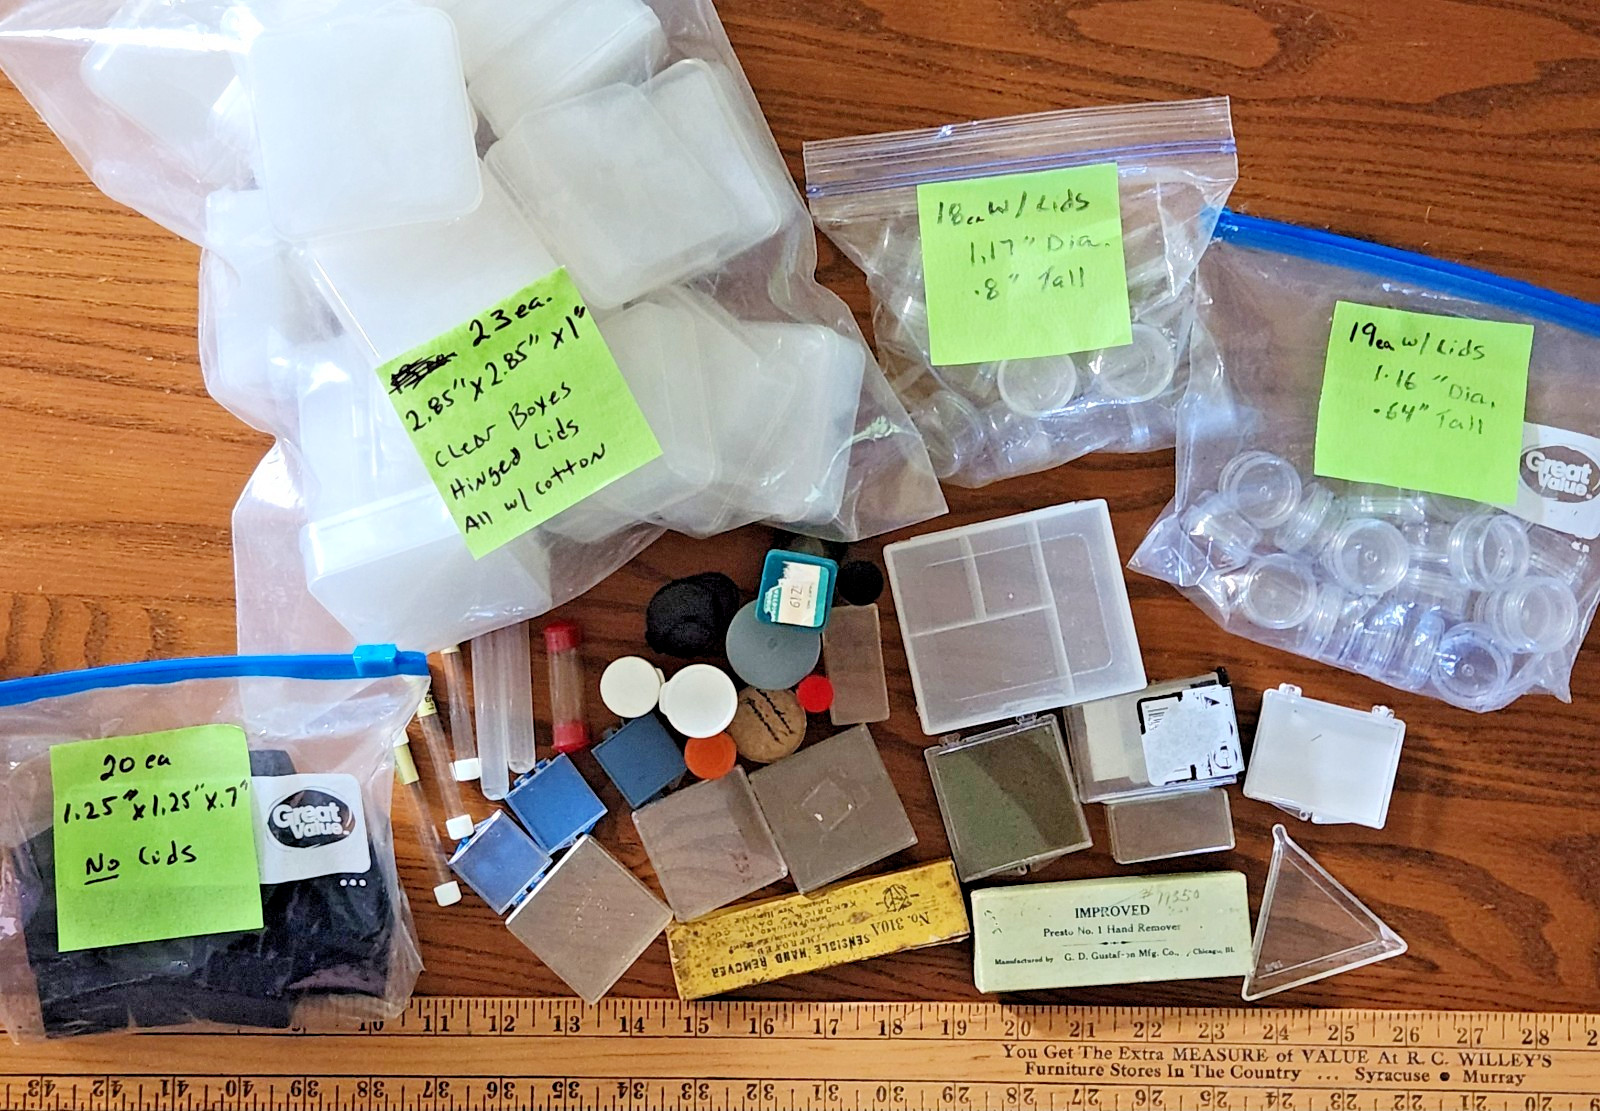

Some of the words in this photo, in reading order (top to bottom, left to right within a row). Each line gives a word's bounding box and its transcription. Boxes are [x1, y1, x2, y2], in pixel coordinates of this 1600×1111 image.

[1038, 267, 1084, 290] Tall
[509, 382, 571, 430] Boxes
[1437, 409, 1483, 434] Tall
[450, 448, 520, 499] Hinged
[1526, 451, 1592, 484] Great
[1538, 474, 1587, 496] Value
[466, 512, 492, 533] All
[100, 755, 135, 781] 20
[146, 755, 171, 768] ea
[273, 801, 341, 828] Great
[290, 822, 343, 839] Value
[86, 853, 120, 875] No
[906, 911, 931, 929] No.
[1075, 905, 1150, 919] IMPROVED
[738, 918, 774, 934] DAVI
[870, 916, 905, 937] 310A
[1044, 928, 1074, 937] Presto
[1078, 926, 1094, 935] No.
[1097, 926, 1102, 934] 1
[1107, 924, 1134, 934] Hand
[1138, 923, 1181, 933] Remover
[813, 932, 870, 956] SENSIBLE
[710, 955, 768, 980] REMOVER
[773, 947, 808, 965] HAND
[995, 956, 1044, 965] Manufactured
[1045, 956, 1054, 964] by
[1064, 953, 1075, 962] G.
[1078, 952, 1088, 961] D.
[1139, 949, 1160, 960] Mfg.
[423, 1016, 451, 1033] 11
[488, 1016, 515, 1033] 12
[554, 1016, 581, 1033] 13
[619, 1016, 645, 1033] 14
[684, 1016, 710, 1034] 15
[748, 1016, 775, 1034] 16
[813, 1018, 839, 1036] 17
[878, 1018, 903, 1036] 18
[941, 1018, 967, 1036] 19
[1004, 1019, 1031, 1036] 20
[1069, 1020, 1095, 1037] 21
[1134, 1020, 1162, 1038] 22
[1198, 1022, 1225, 1040] 23
[1262, 1023, 1289, 1041] 24
[1328, 1025, 1355, 1042] 25
[1392, 1026, 1420, 1043] 26
[1456, 1027, 1484, 1044] 27
[1521, 1028, 1550, 1045] 28
[1003, 1044, 1037, 1060] You
[1043, 1046, 1073, 1059] Get
[1079, 1045, 1112, 1060] The
[1119, 1047, 1164, 1062] Extra
[1172, 1047, 1268, 1062] MEASURE
[1276, 1049, 1294, 1062] of
[1301, 1049, 1369, 1064] VALUE
[1378, 1051, 1399, 1065] At
[1407, 1051, 1425, 1065] R.
[1432, 1052, 1449, 1065] C.
[1459, 1052, 1552, 1068] WILLEY'S
[1025, 1062, 1104, 1077] Furniture
[1110, 1063, 1162, 1078] Stores
[1167, 1064, 1185, 1078] In
[1190, 1064, 1225, 1079] The
[1230, 1066, 1302, 1083] Country
[1354, 1066, 1430, 1084] Syracuse
[1463, 1070, 1526, 1086] Murray
